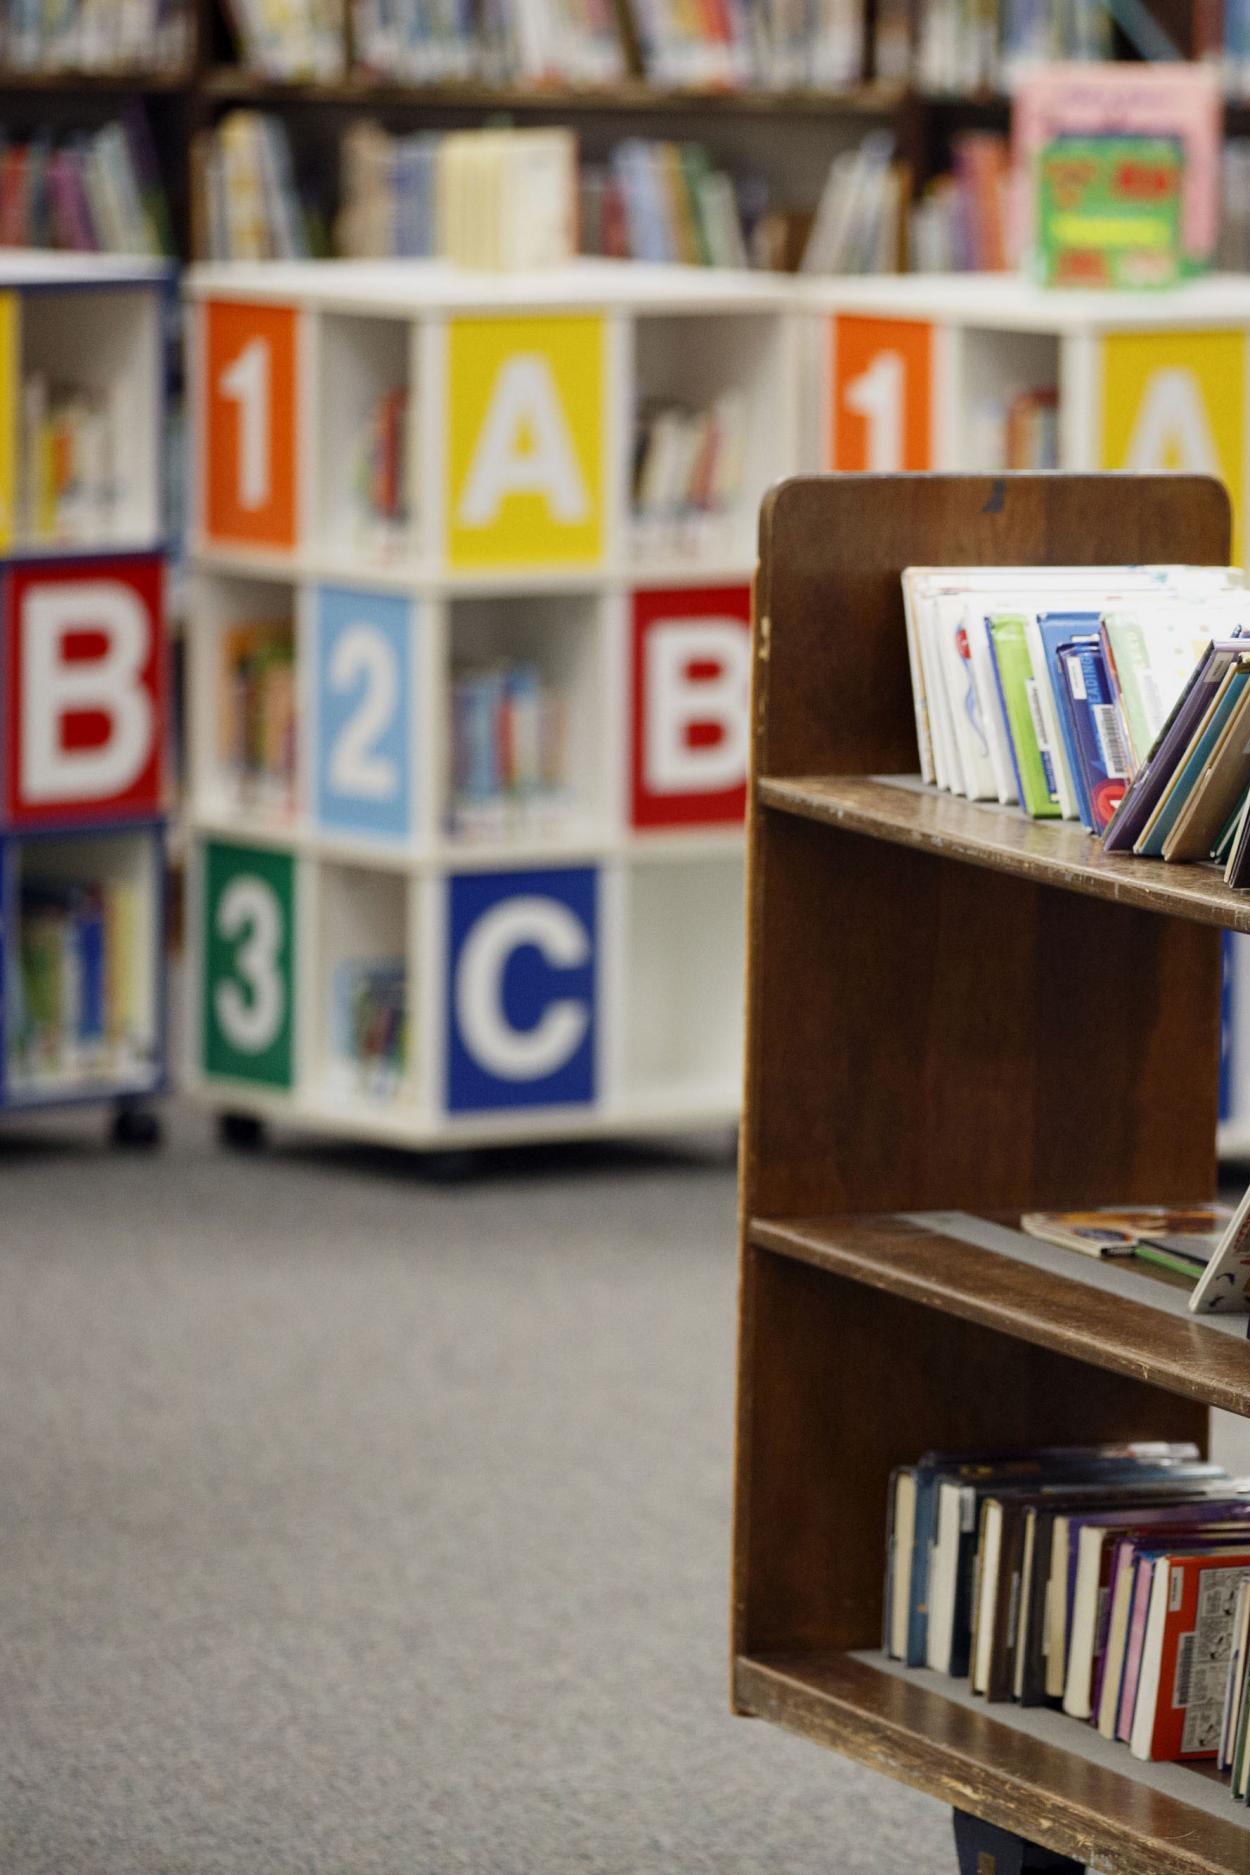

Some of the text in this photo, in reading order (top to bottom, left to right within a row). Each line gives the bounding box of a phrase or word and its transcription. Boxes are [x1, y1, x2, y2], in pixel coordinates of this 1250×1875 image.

[221, 338, 272, 509] 1
[463, 356, 588, 524] A
[848, 351, 903, 471] 1
[1130, 371, 1218, 471] A
[21, 580, 155, 802] B
[331, 627, 398, 798] 2
[646, 619, 750, 793] B
[1079, 654, 1103, 705] EADING
[217, 876, 283, 1051] 3
[457, 896, 590, 1081] C
